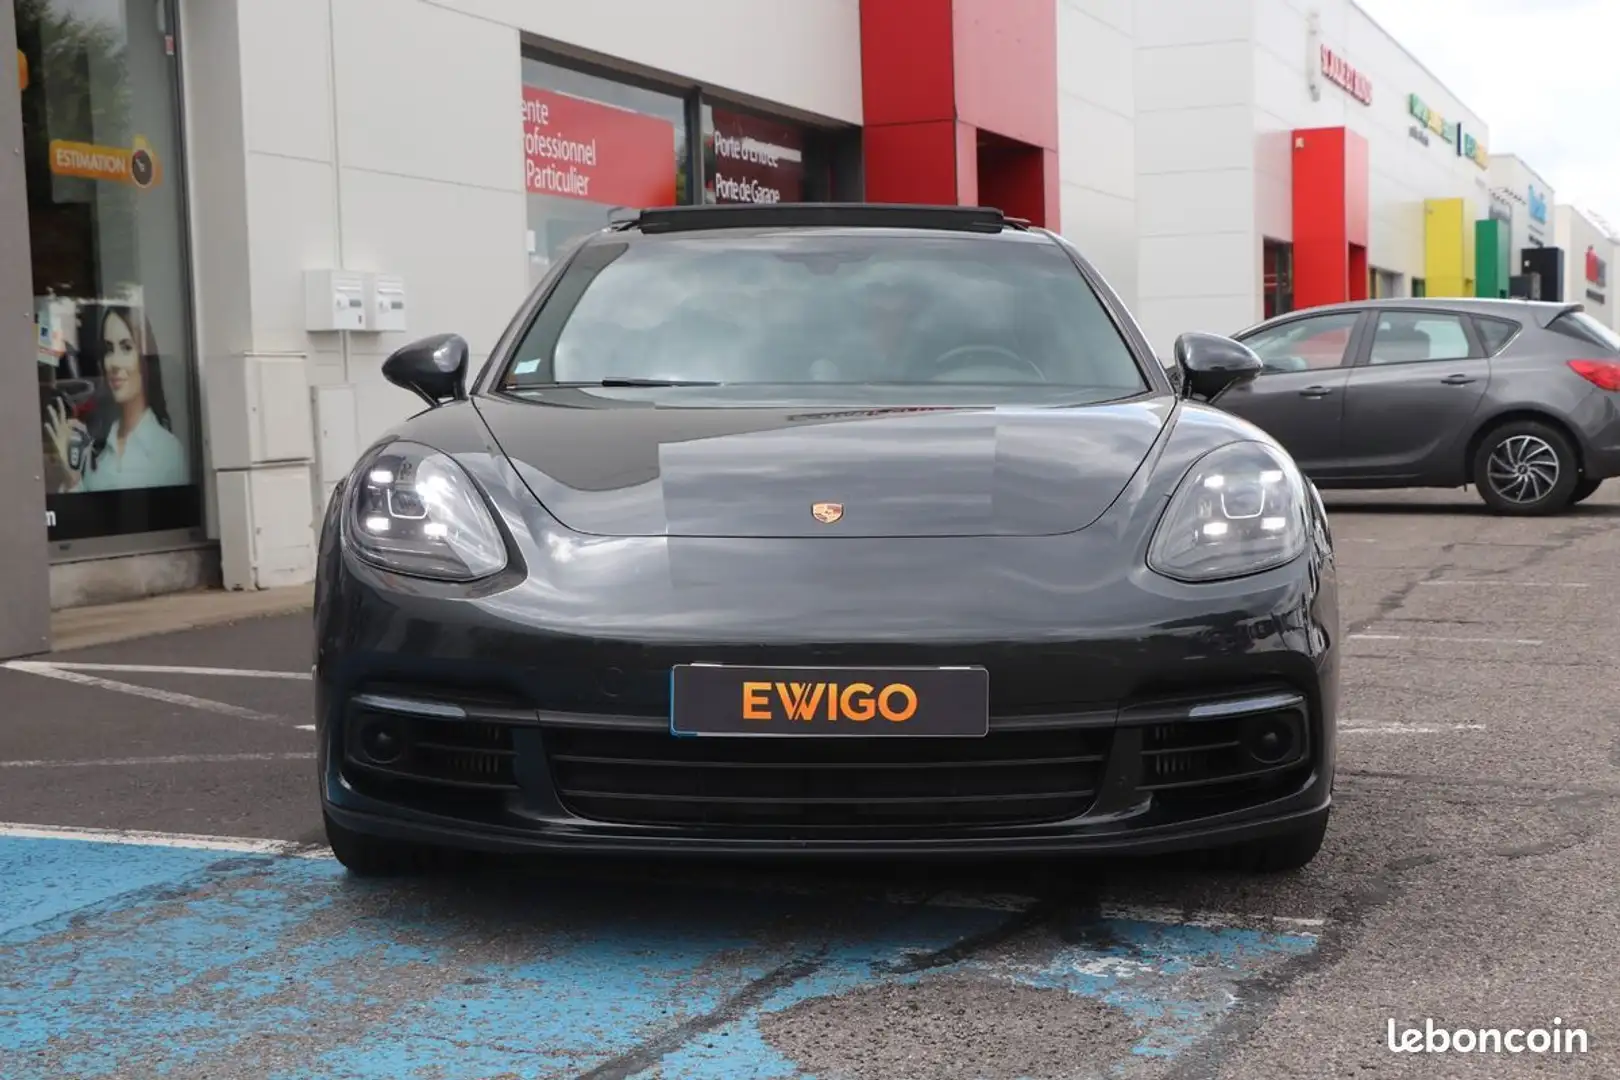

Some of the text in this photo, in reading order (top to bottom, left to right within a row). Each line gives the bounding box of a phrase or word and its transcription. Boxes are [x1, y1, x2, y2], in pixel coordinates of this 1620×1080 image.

[520, 99, 549, 125] ente
[525, 126, 596, 166] ofessionnel
[714, 130, 740, 159] Porte
[56, 148, 126, 173] ESTIMATION
[526, 158, 590, 195] Particulier
[715, 172, 739, 200] Porte
[740, 176, 751, 202] de
[743, 682, 918, 722] EWIGO
